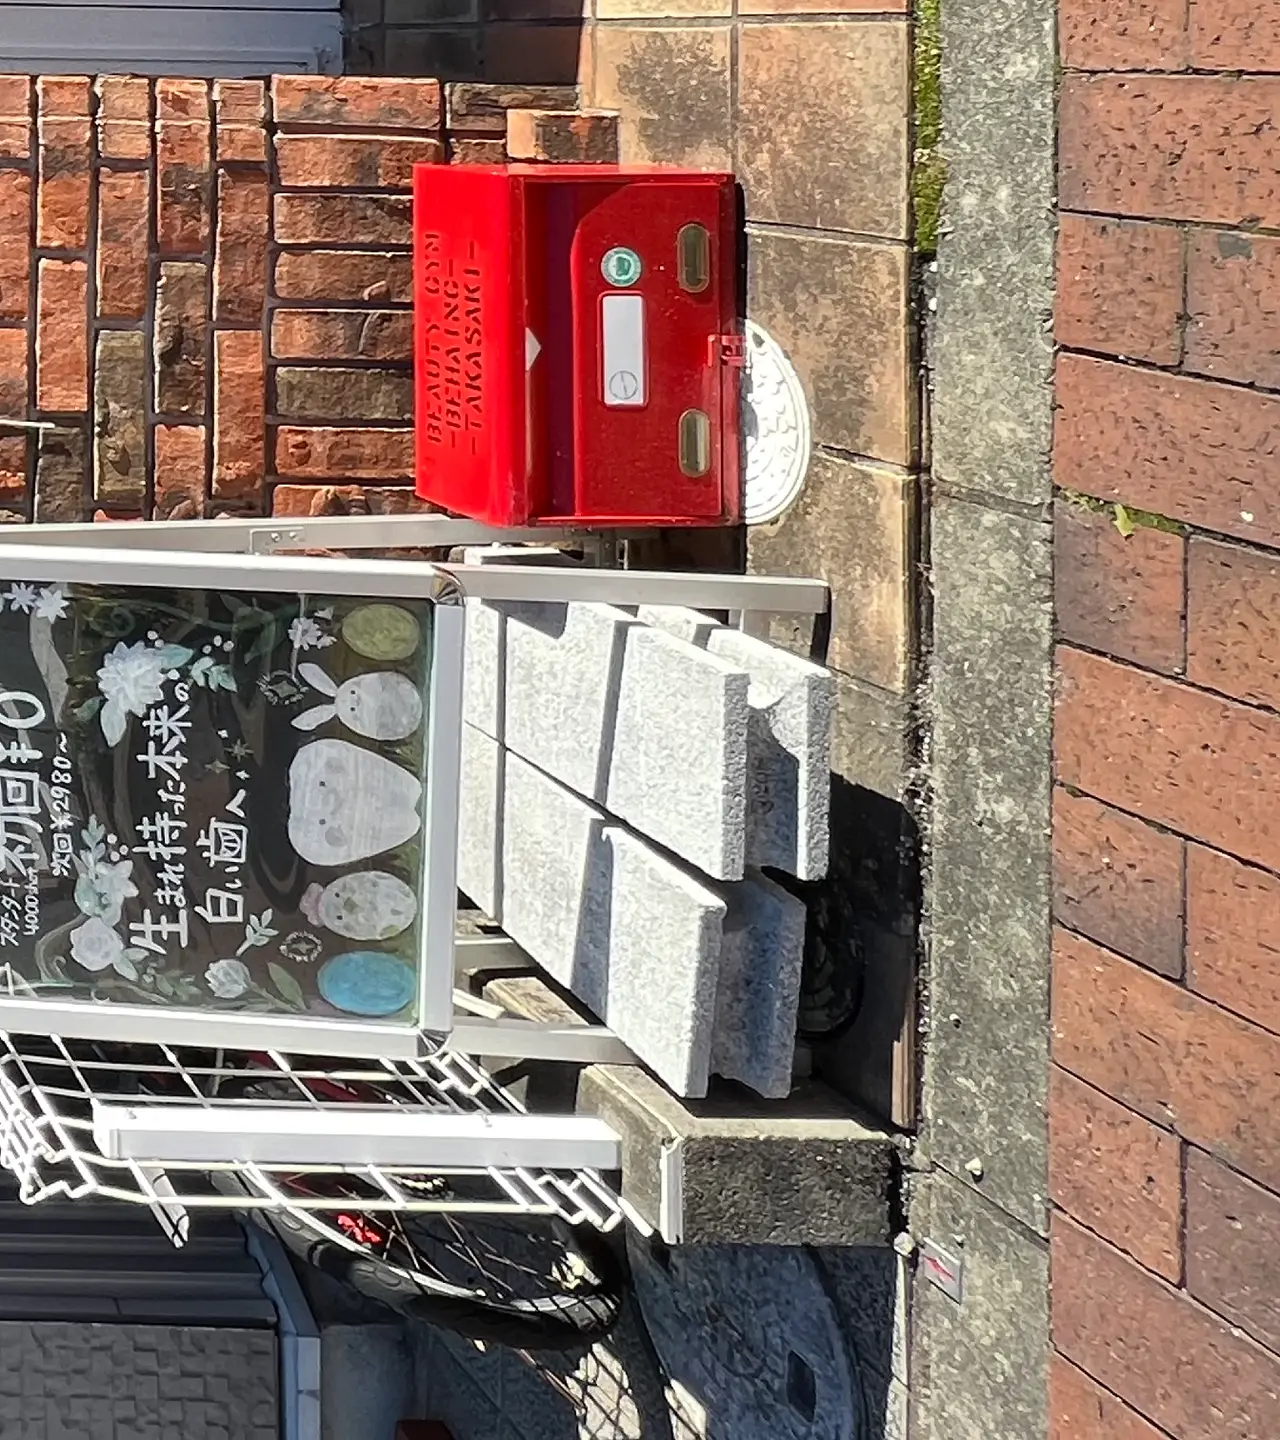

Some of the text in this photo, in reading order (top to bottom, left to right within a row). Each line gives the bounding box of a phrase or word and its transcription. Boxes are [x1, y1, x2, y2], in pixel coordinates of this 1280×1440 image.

[424, 232, 442, 443] BEAUTY GYM
[129, 681, 194, 954] 生まれ持った本来の
